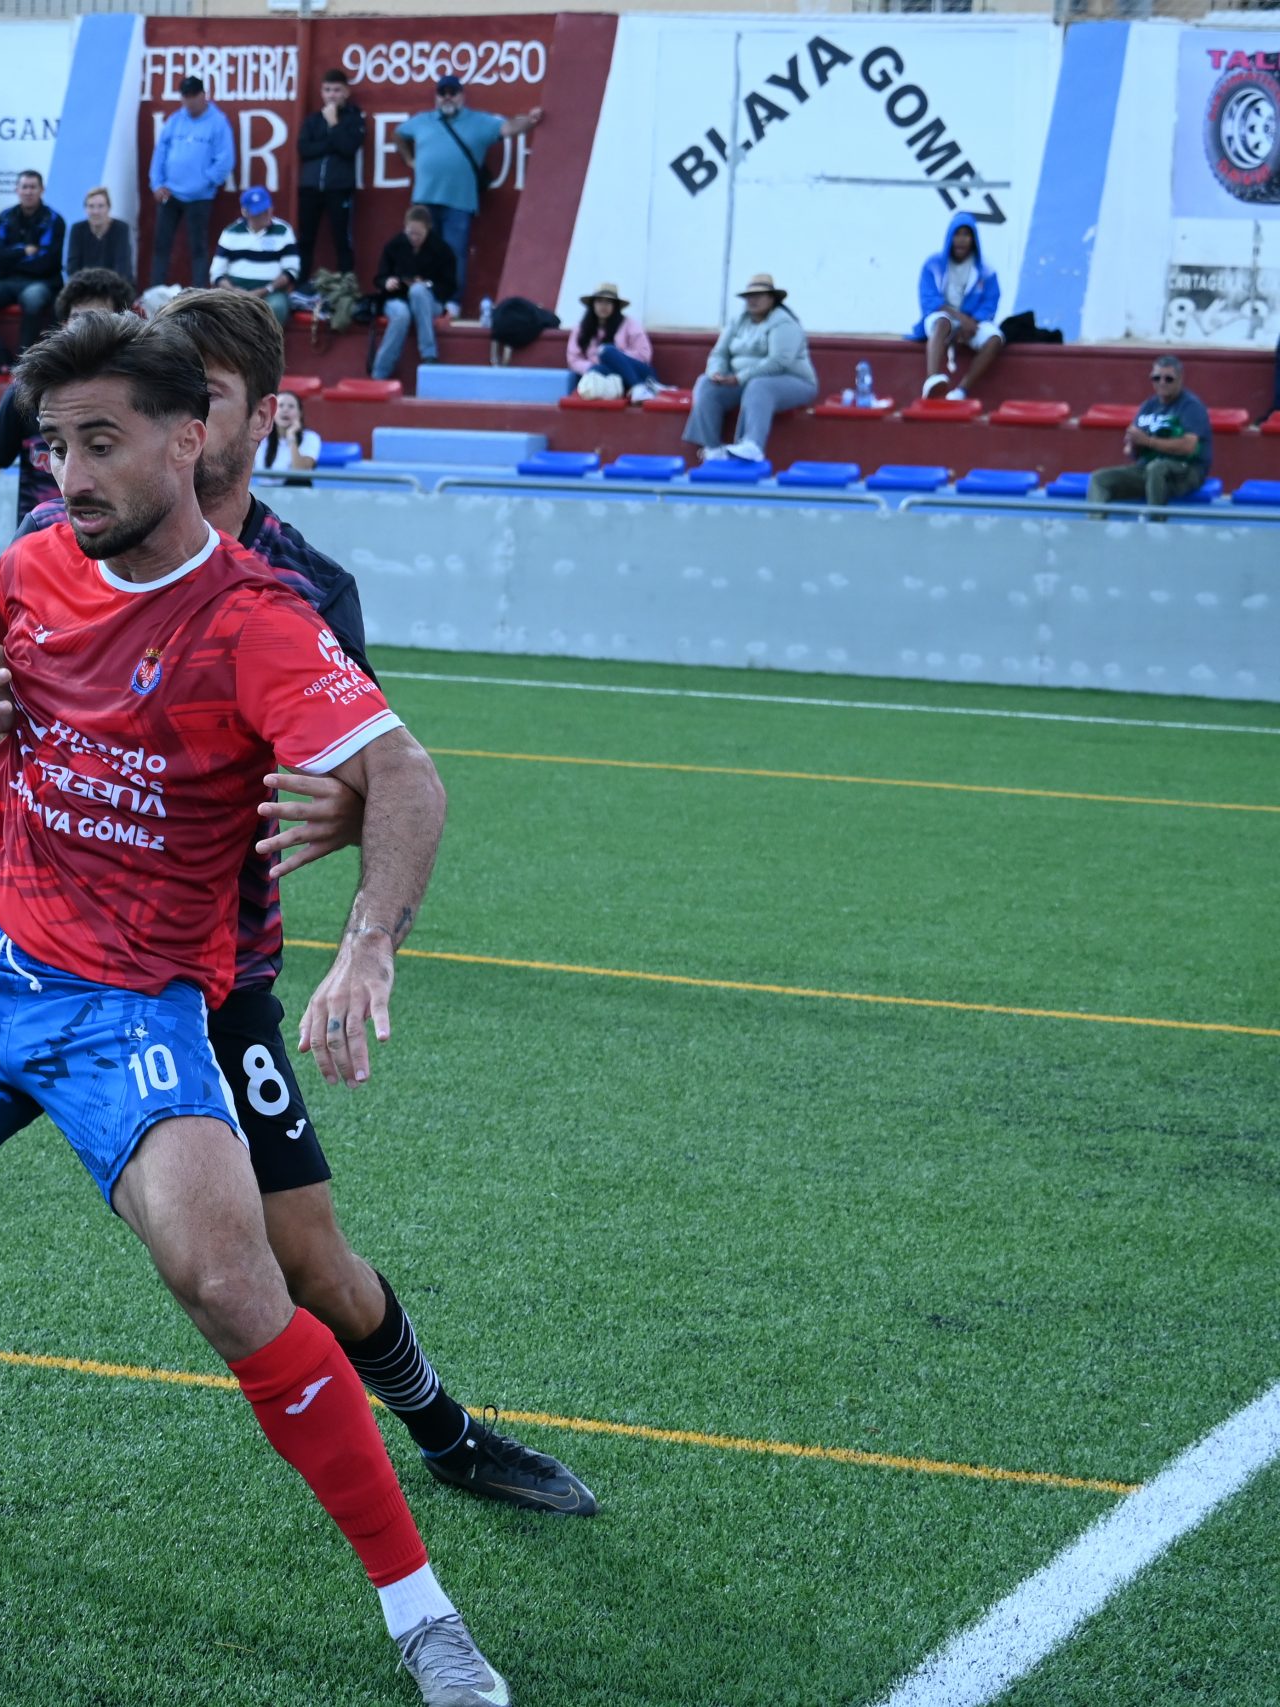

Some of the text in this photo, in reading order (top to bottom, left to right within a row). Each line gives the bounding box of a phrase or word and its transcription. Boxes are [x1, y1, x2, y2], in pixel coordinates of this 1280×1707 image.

[141, 45, 299, 102] FERRETERIA
[342, 40, 547, 85] 968569250
[1206, 49, 1280, 70] TAL
[669, 35, 854, 198] BLAYA
[304, 670, 343, 696] OBRAS
[77, 815, 166, 852] GÓMEZ
[128, 1043, 179, 1100] 10
[242, 1044, 290, 1116] 8
